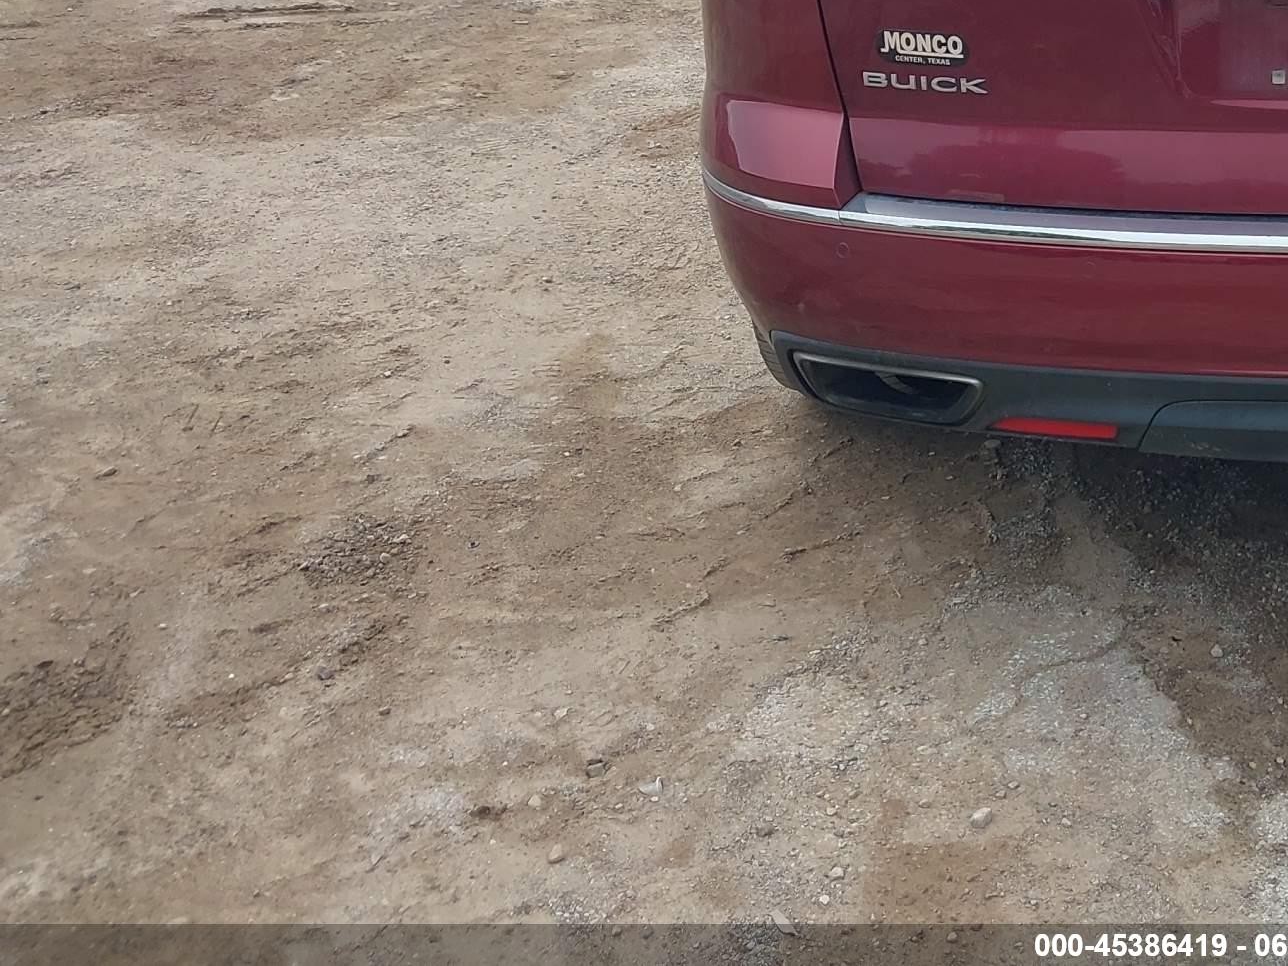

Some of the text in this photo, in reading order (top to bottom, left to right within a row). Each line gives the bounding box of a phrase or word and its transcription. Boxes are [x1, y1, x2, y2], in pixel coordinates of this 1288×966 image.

[880, 30, 964, 58] MONCO
[895, 55, 951, 66] CENTER, TEXAS
[862, 71, 989, 94] BUICK
